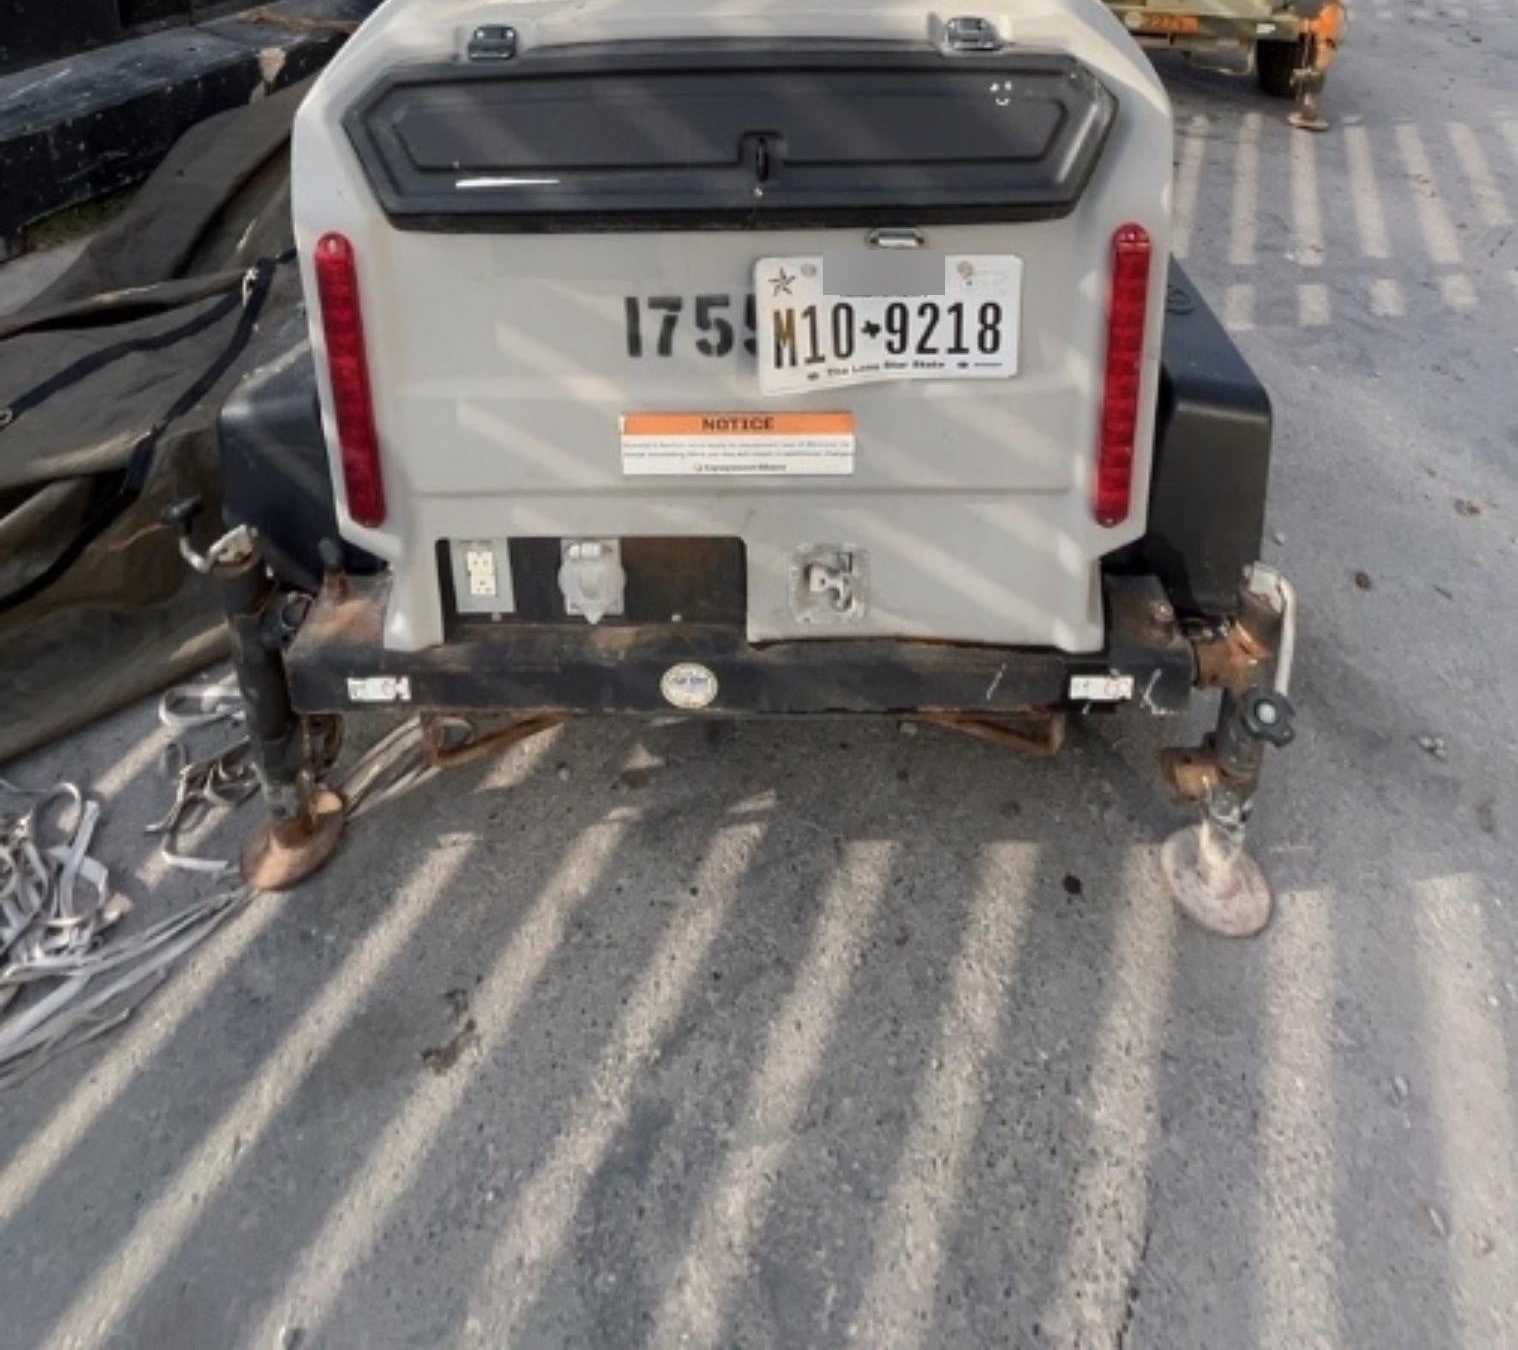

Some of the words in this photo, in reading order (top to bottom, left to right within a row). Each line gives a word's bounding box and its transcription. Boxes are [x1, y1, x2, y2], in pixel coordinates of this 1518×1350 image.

[885, 302, 1002, 355] 9218
[884, 359, 909, 370] Star
[912, 359, 946, 369] State
[701, 416, 775, 431] NOTICE
